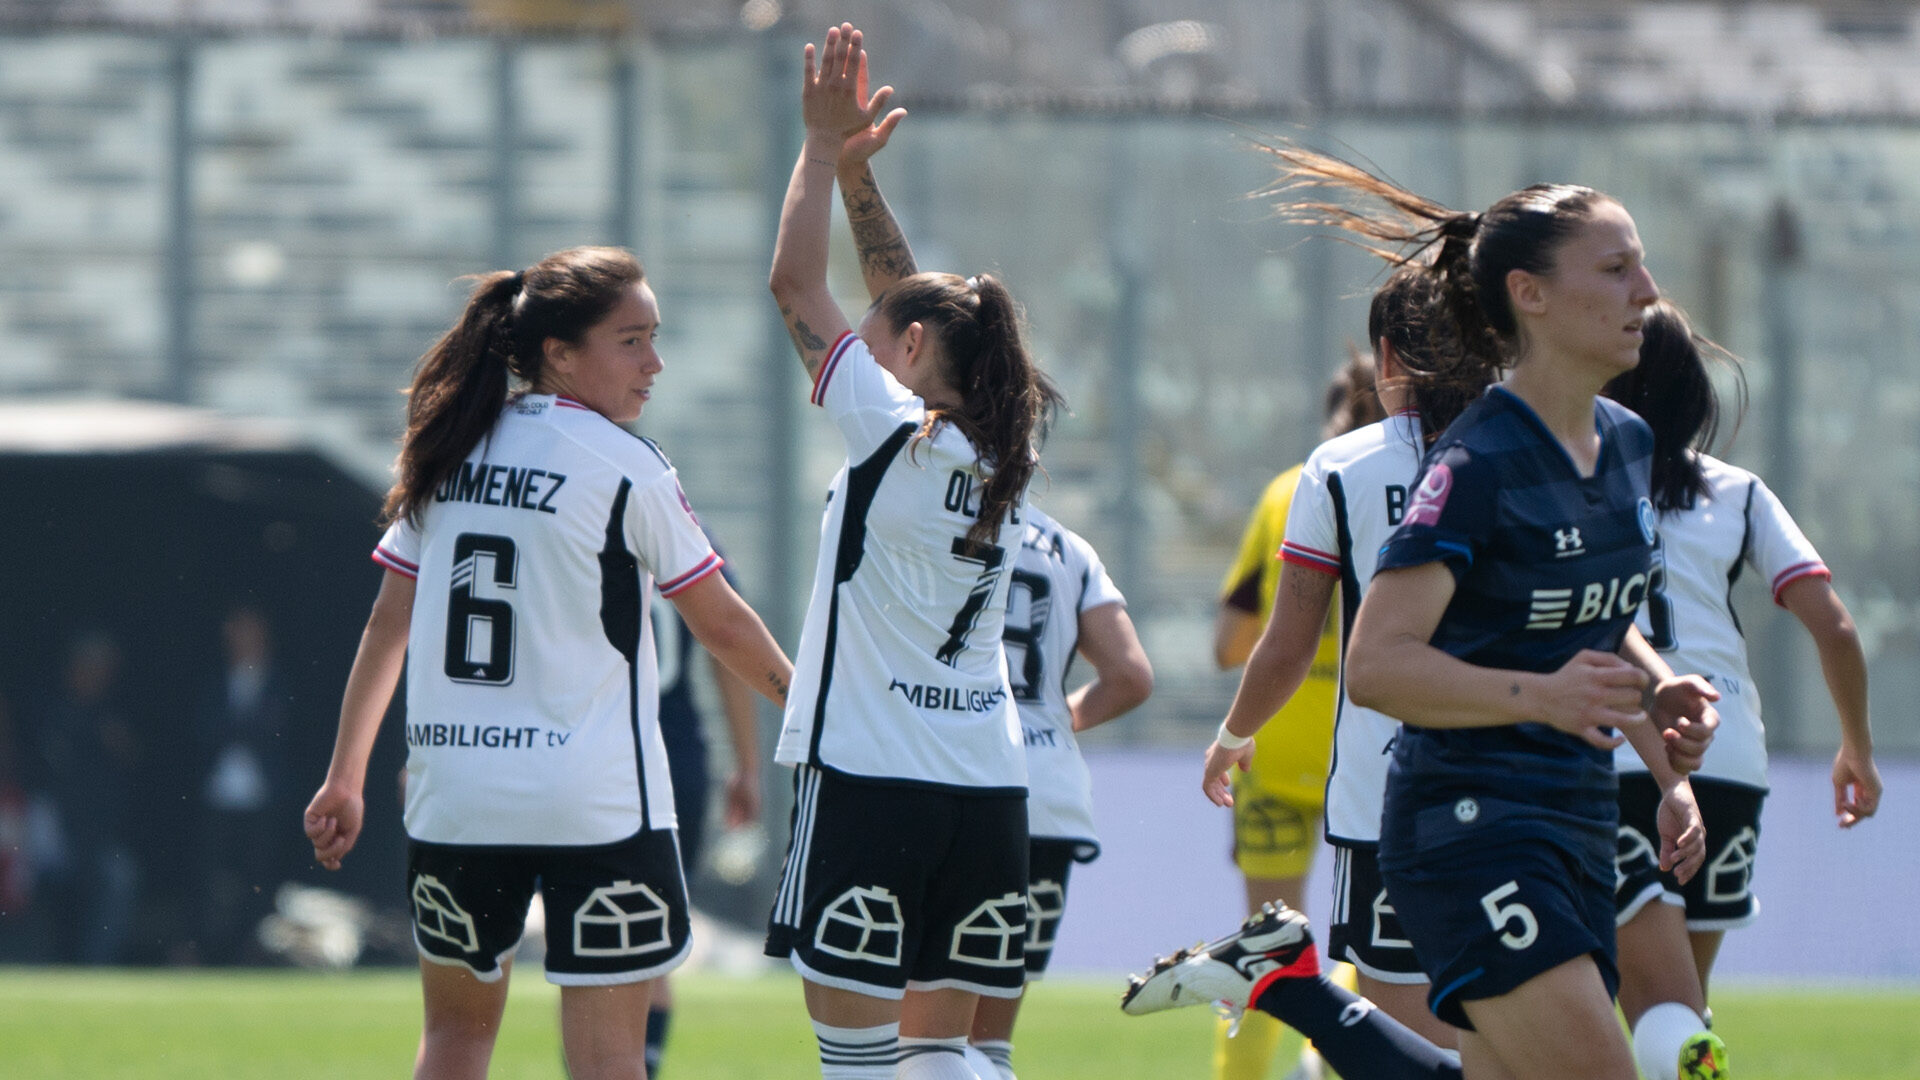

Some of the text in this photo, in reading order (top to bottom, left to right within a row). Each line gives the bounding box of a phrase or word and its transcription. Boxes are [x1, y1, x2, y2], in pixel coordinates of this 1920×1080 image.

[444, 532, 519, 687] 6
[936, 536, 1007, 669] 7
[1575, 572, 1650, 625] BIC
[546, 730, 571, 747] tv
[1480, 879, 1539, 950] 5
